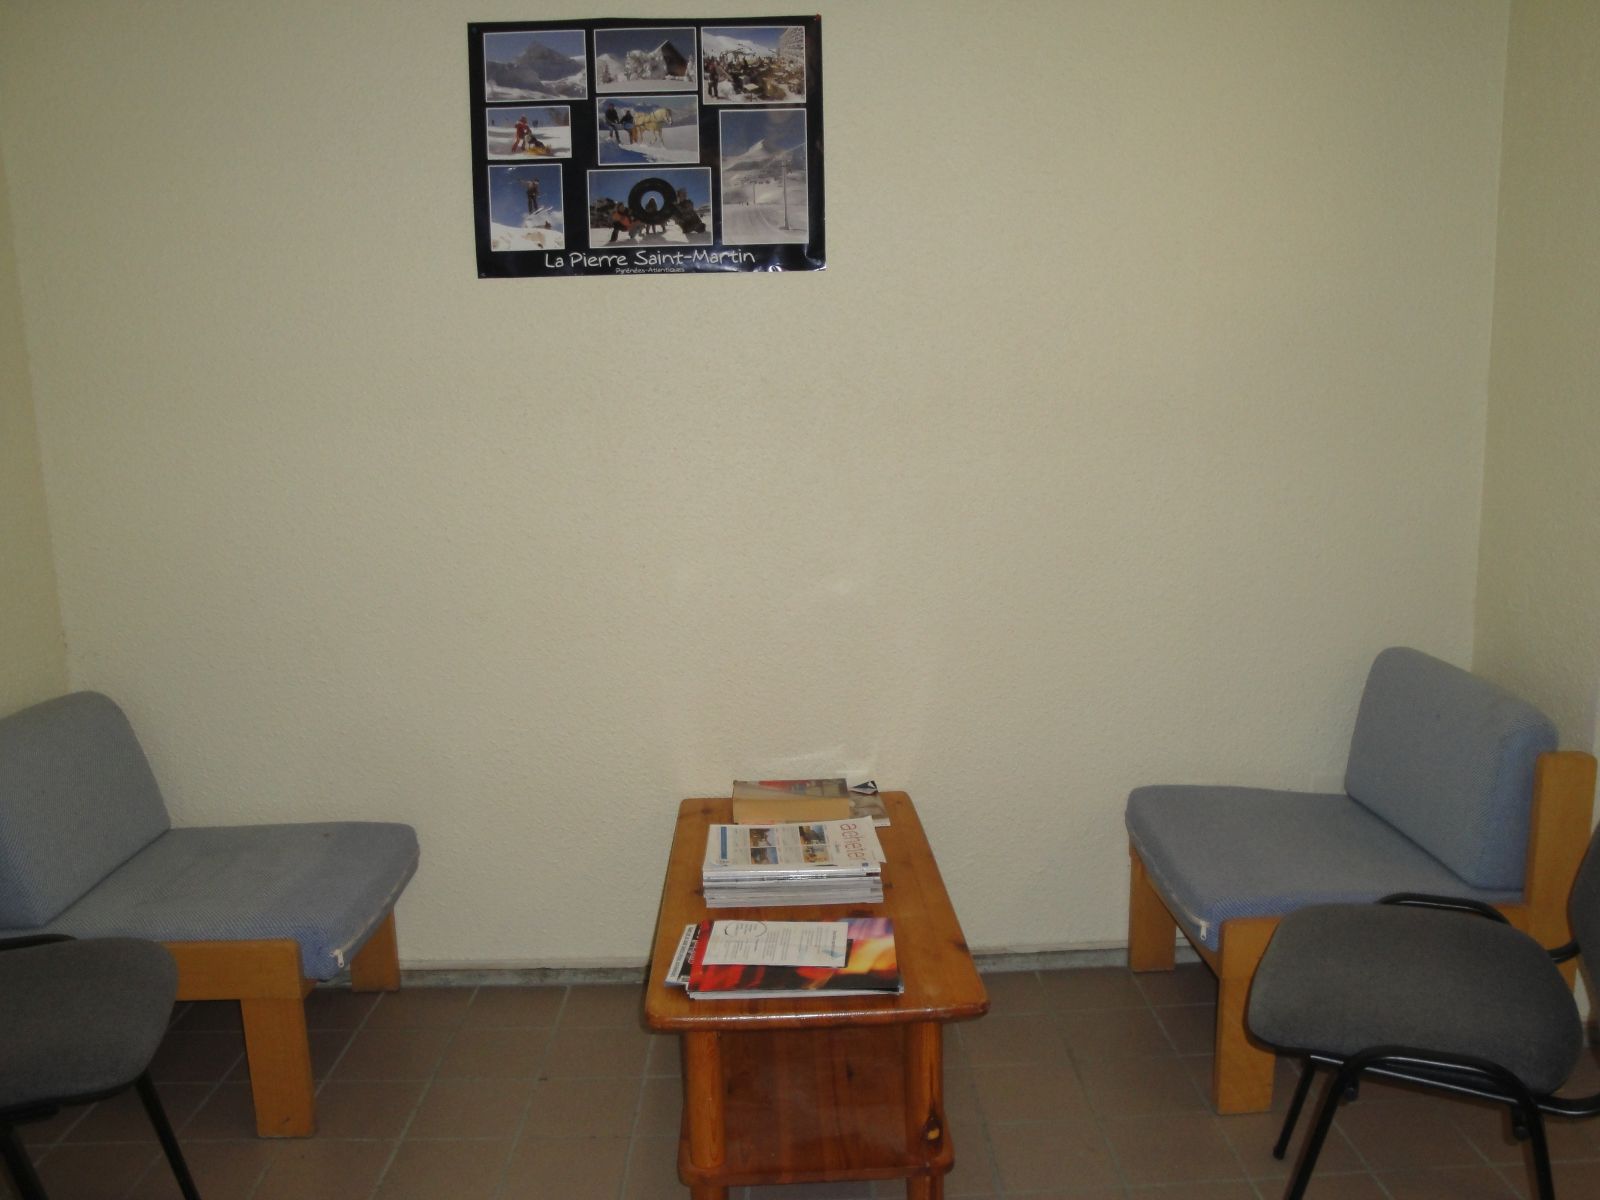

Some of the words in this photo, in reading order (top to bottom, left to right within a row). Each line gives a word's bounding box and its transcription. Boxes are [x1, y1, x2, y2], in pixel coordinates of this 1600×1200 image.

[544, 251, 564, 268] La
[570, 251, 627, 268] Pierre
[634, 248, 756, 266] Saint-Martin
